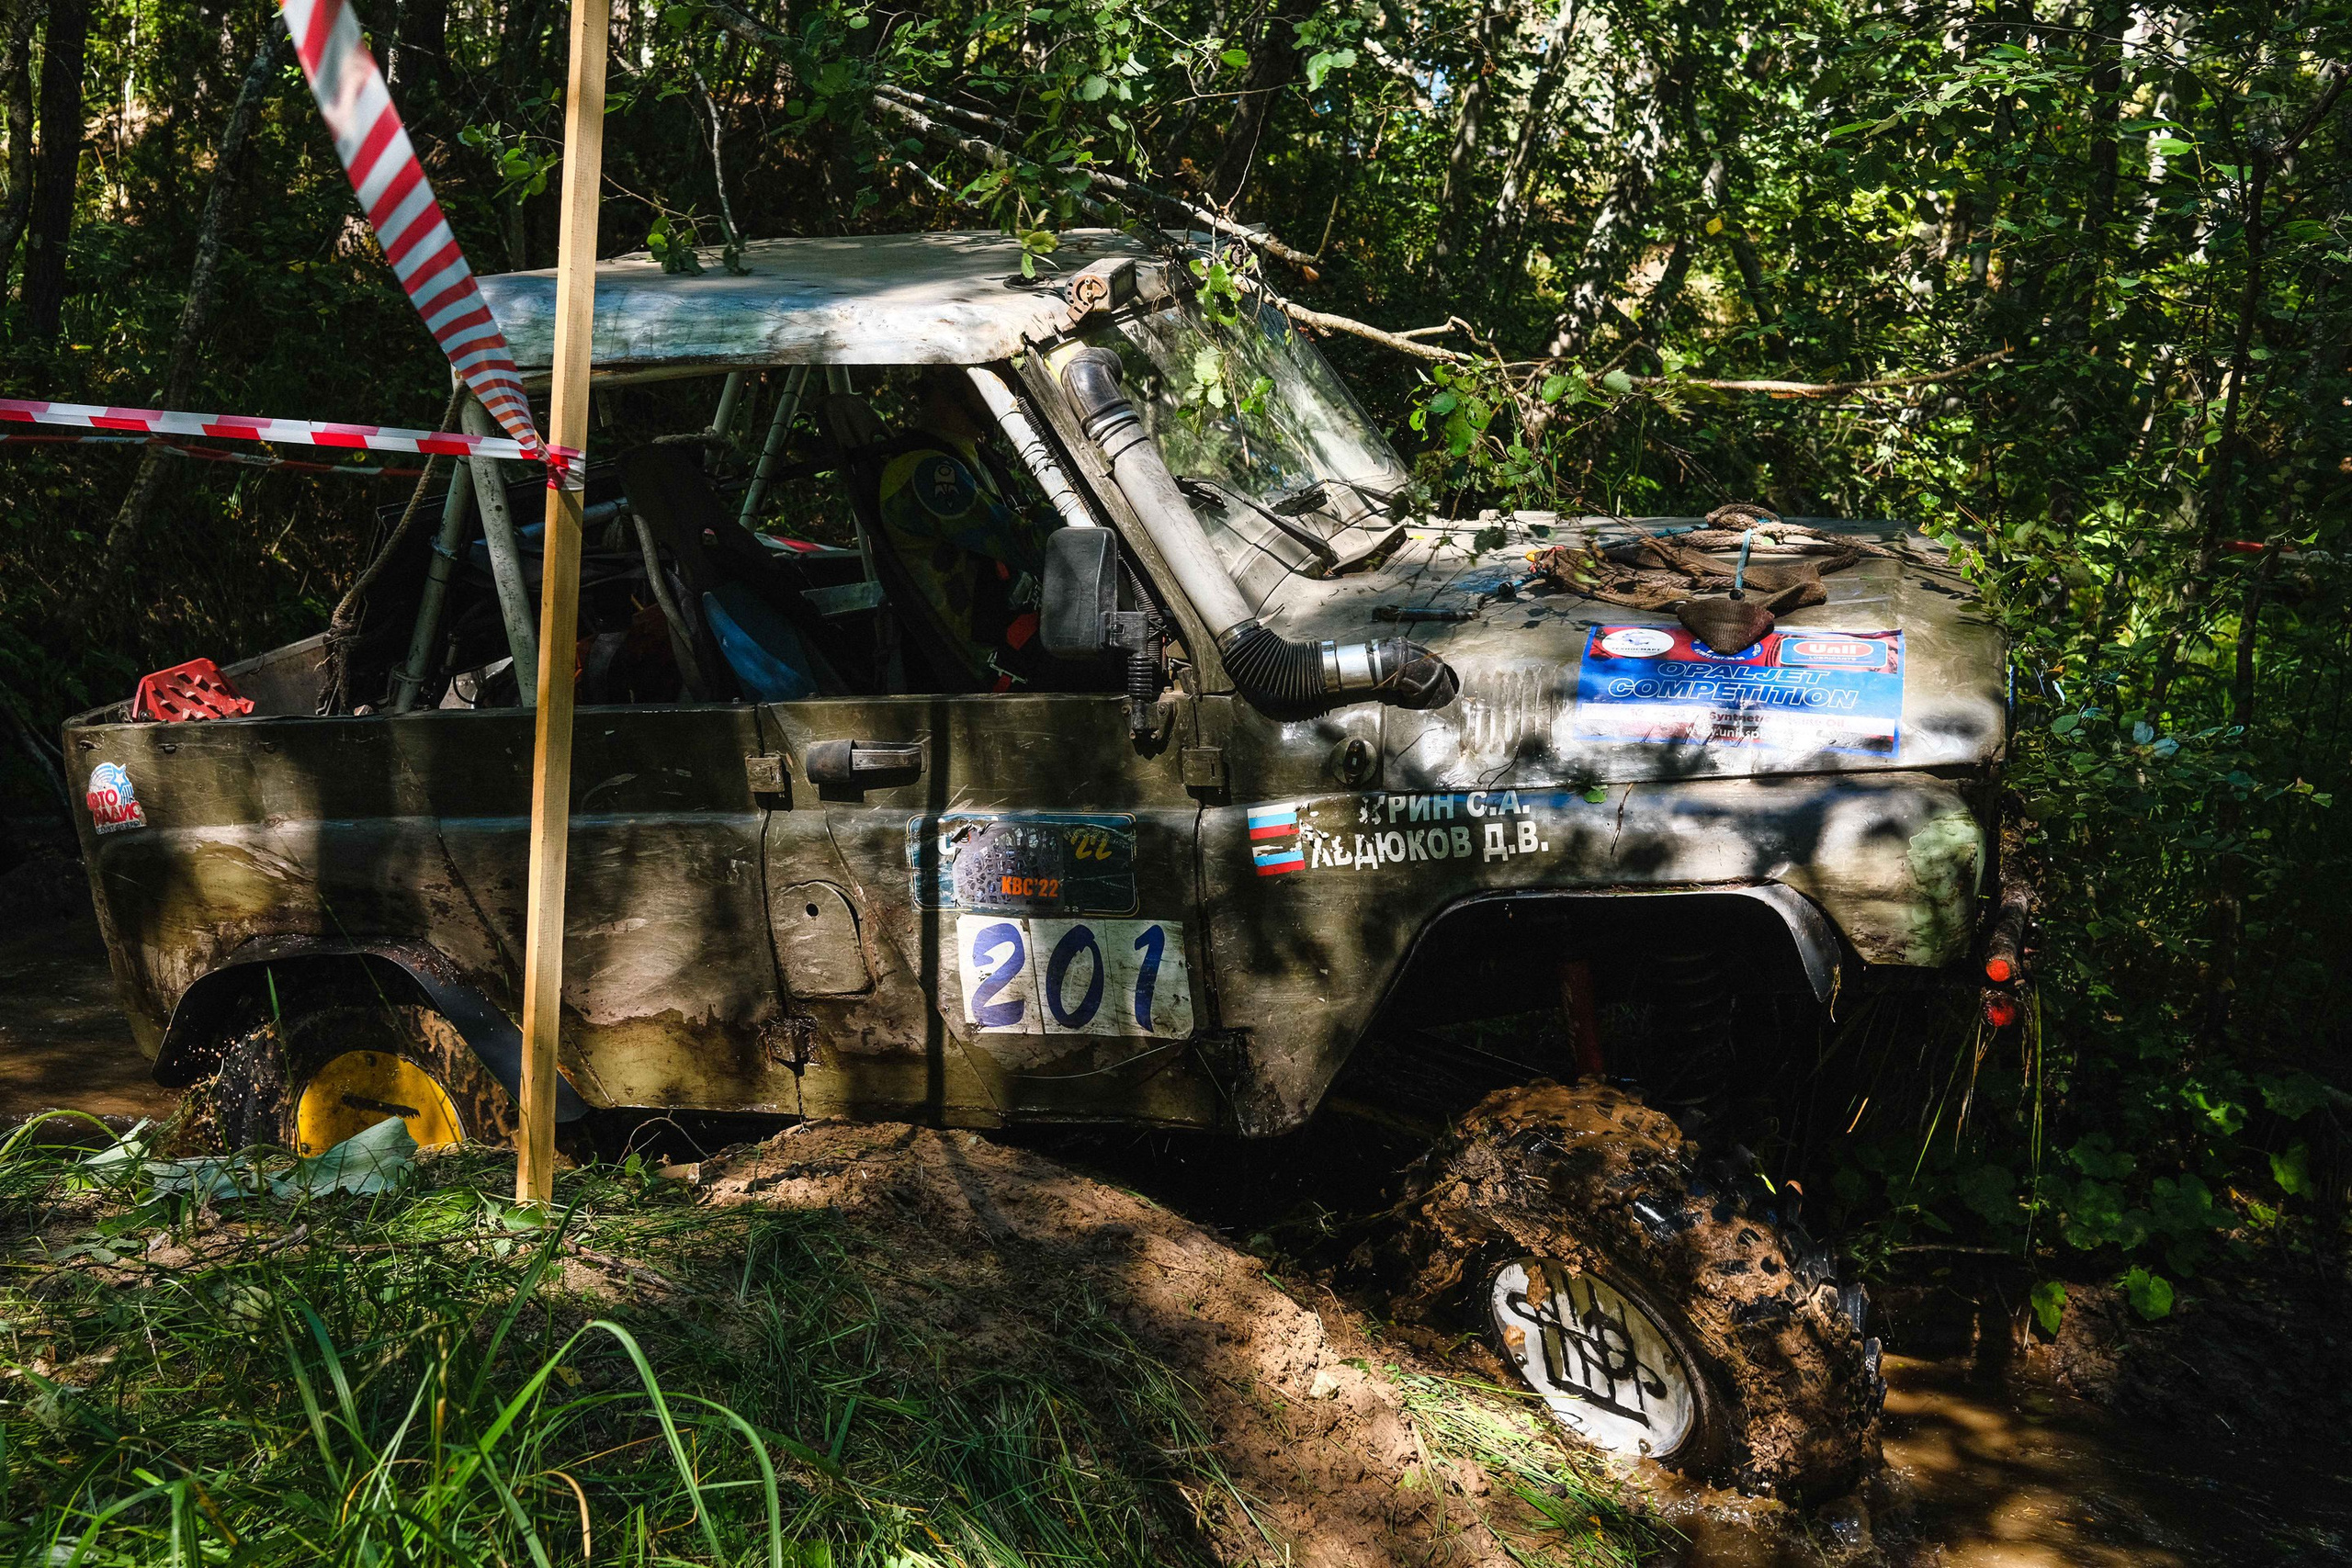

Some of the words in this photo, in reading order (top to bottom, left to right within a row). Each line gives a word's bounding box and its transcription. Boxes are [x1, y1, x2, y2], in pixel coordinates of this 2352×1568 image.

[1809, 644, 1856, 654] Unil
[1657, 662, 1831, 684] OPALJET
[1608, 678, 1860, 709] COMPETITION
[1466, 790, 1531, 818] С.А.
[1483, 820, 1550, 863] Д.В.
[971, 922, 1167, 1033] 201
